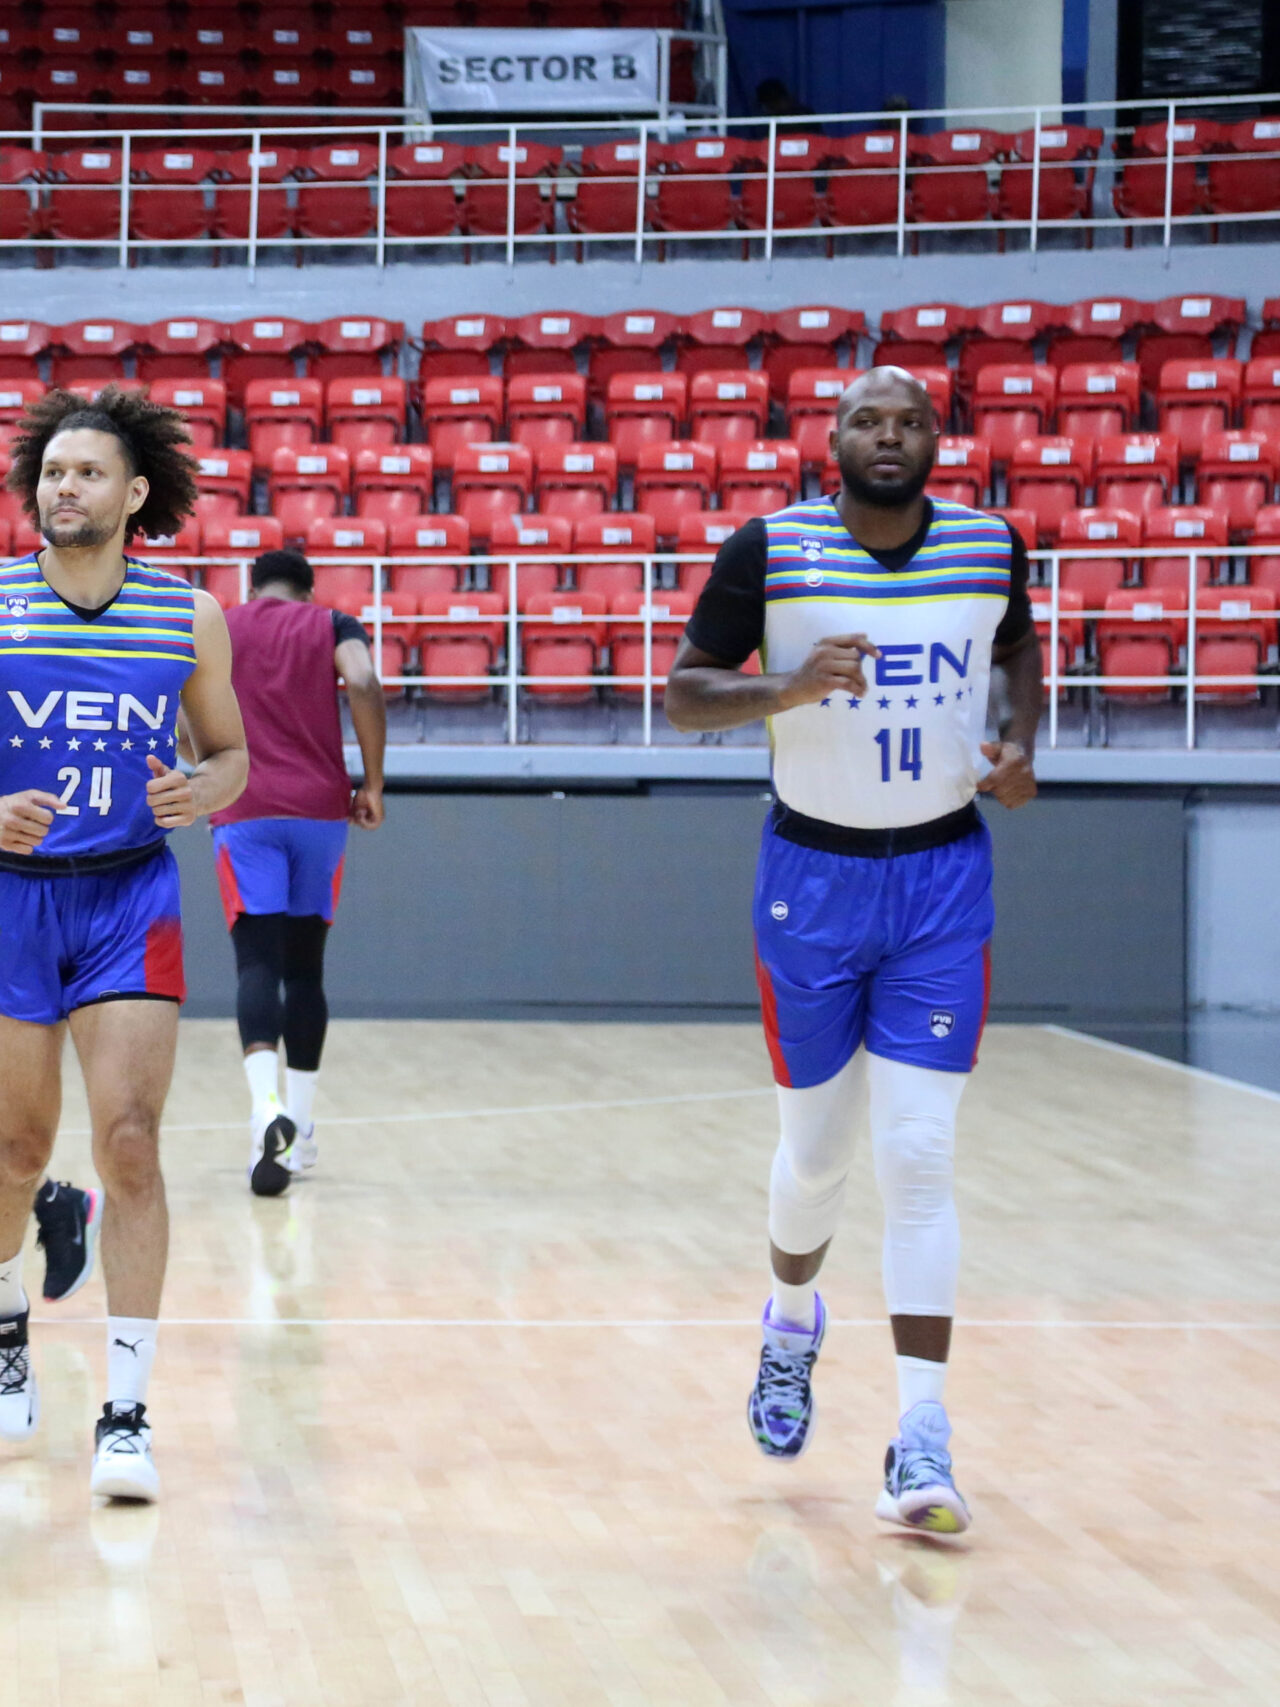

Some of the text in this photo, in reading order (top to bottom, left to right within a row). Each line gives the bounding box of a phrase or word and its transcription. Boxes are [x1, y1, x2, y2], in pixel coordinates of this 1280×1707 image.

[438, 53, 637, 84] SECTOR B
[802, 539, 821, 549] FVB
[8, 598, 26, 606] FVB
[858, 638, 972, 686] EN
[7, 690, 168, 731] VEN
[873, 727, 922, 782] 14
[55, 766, 112, 816] 24
[933, 1014, 952, 1025] FVB
